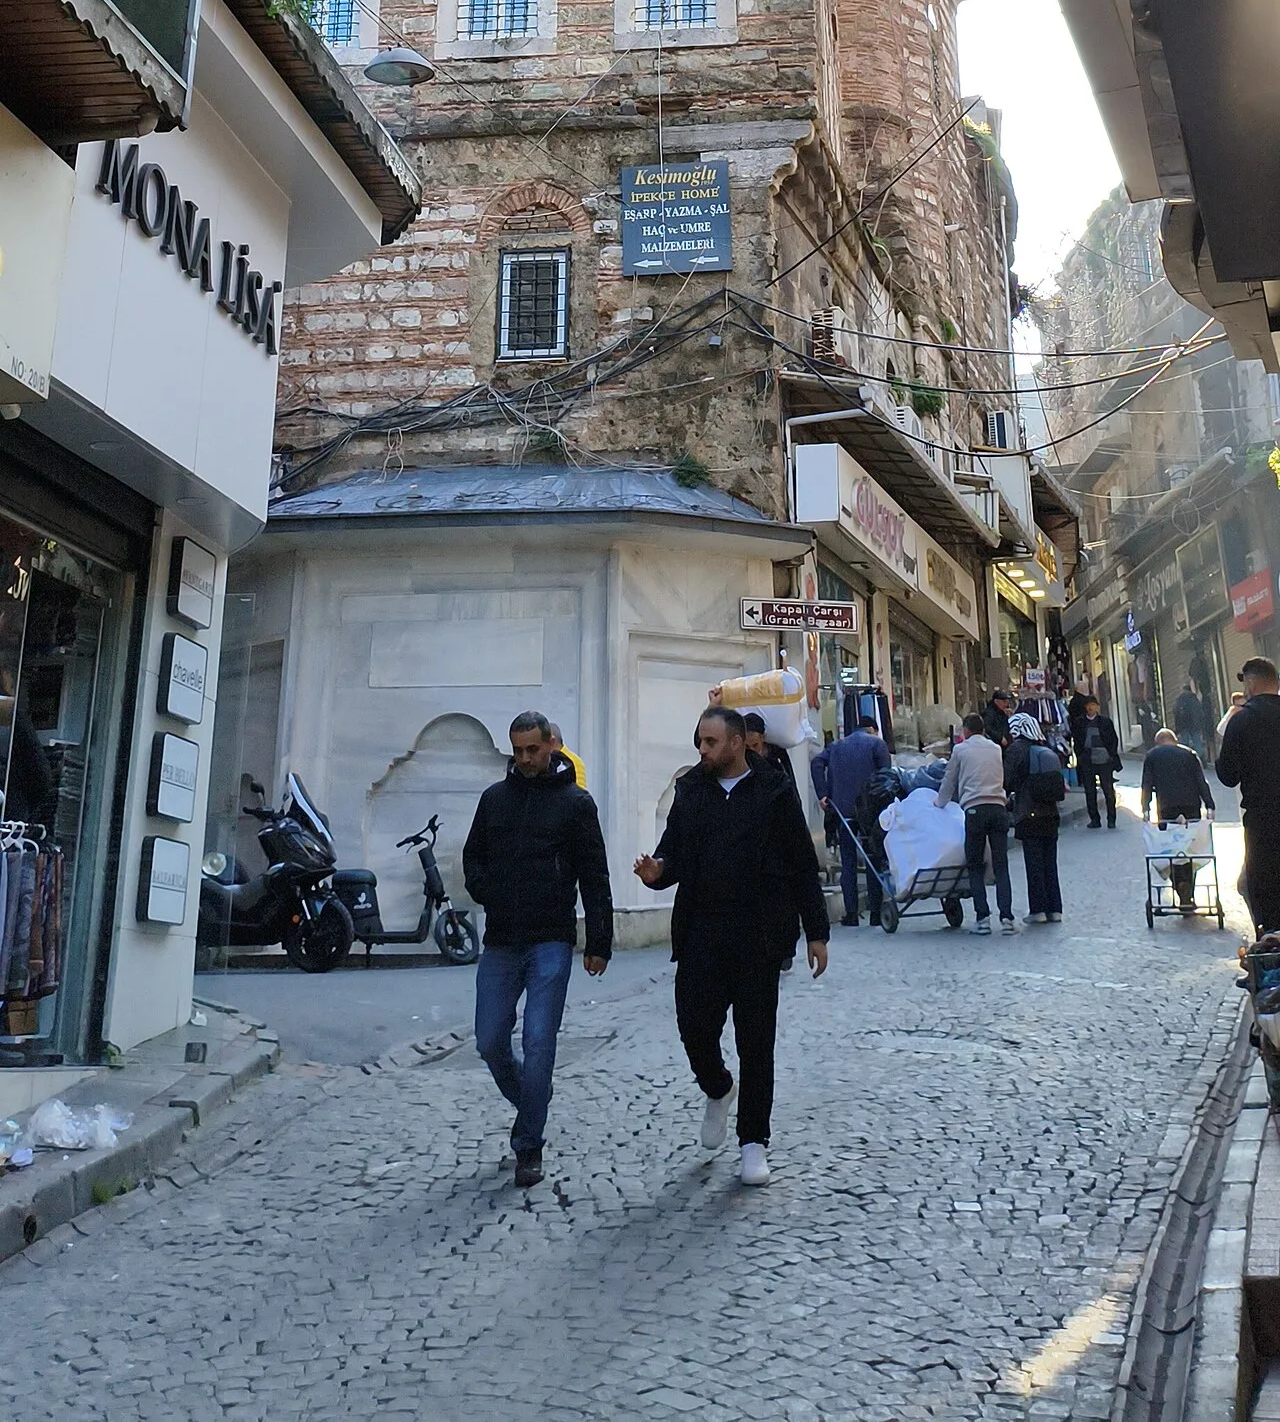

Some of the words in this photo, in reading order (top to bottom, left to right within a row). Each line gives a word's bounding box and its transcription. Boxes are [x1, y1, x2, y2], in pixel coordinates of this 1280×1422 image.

[634, 165, 717, 187] Kesimoğlu
[681, 187, 719, 199] HOME
[95, 139, 214, 292] MONA
[624, 208, 657, 222] EŞARP
[665, 206, 703, 218] YAZMA
[709, 203, 730, 217] ŞAL
[680, 222, 712, 233] UMRE
[641, 237, 715, 253] MALZEMELERİ
[773, 603, 809, 615] Kapalı
[813, 605, 842, 617] Çarşı
[765, 616, 803, 626] (Grand
